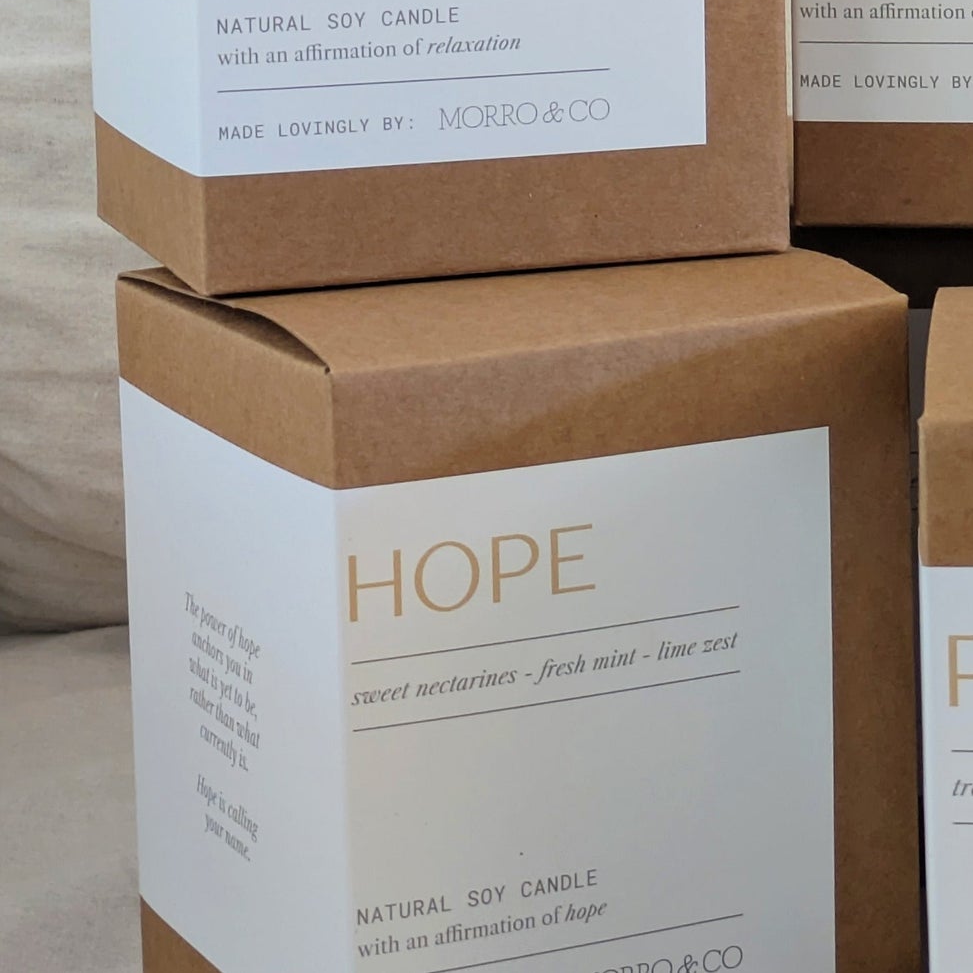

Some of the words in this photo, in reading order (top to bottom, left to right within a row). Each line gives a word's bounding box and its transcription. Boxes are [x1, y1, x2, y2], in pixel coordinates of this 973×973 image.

[216, 15, 312, 35] NATURAL
[327, 12, 366, 30] SOY
[381, 7, 459, 27] CANDLE
[799, 3, 837, 20] with
[843, 7, 864, 20] an
[869, 3, 965, 20] affirmation
[218, 47, 259, 66] with
[266, 48, 288, 64] an
[294, 41, 397, 62] affirmation
[403, 38, 424, 57] of
[427, 35, 521, 55] relaxation
[799, 75, 841, 89] MADE
[854, 75, 939, 90] LOVINGLY
[218, 124, 265, 141] MADE
[278, 118, 369, 138] LOVINGLY
[383, 117, 415, 131] BY:
[348, 523, 596, 622] HOPE
[185, 592, 199, 618] The
[200, 607, 227, 636] power
[228, 625, 239, 649] of
[239, 627, 261, 660] hope
[189, 657, 209, 684] what
[211, 668, 218, 690] is
[220, 680, 232, 700] yet
[234, 687, 242, 707] to
[192, 632, 223, 665] anchors
[225, 655, 241, 677] you
[243, 661, 253, 684] in
[351, 683, 410, 707] sweet
[415, 668, 517, 698] nectarines
[534, 654, 585, 686] fresh
[592, 649, 636, 671] mint
[656, 641, 697, 662] lime
[703, 632, 738, 653] zest
[190, 688, 214, 715] rather
[216, 703, 234, 732] than
[236, 721, 260, 749] what
[200, 725, 237, 768] currently
[197, 774, 217, 807] Hope
[219, 791, 226, 814] is
[228, 805, 258, 843] calling
[204, 813, 224, 837] your
[356, 895, 452, 926] NATURAL
[468, 886, 505, 908] SOY
[520, 868, 598, 898] CANDLE
[358, 935, 400, 958] with
[406, 933, 429, 952] an
[434, 915, 536, 947] affirmation
[541, 907, 564, 927] of
[564, 899, 608, 924] hope
